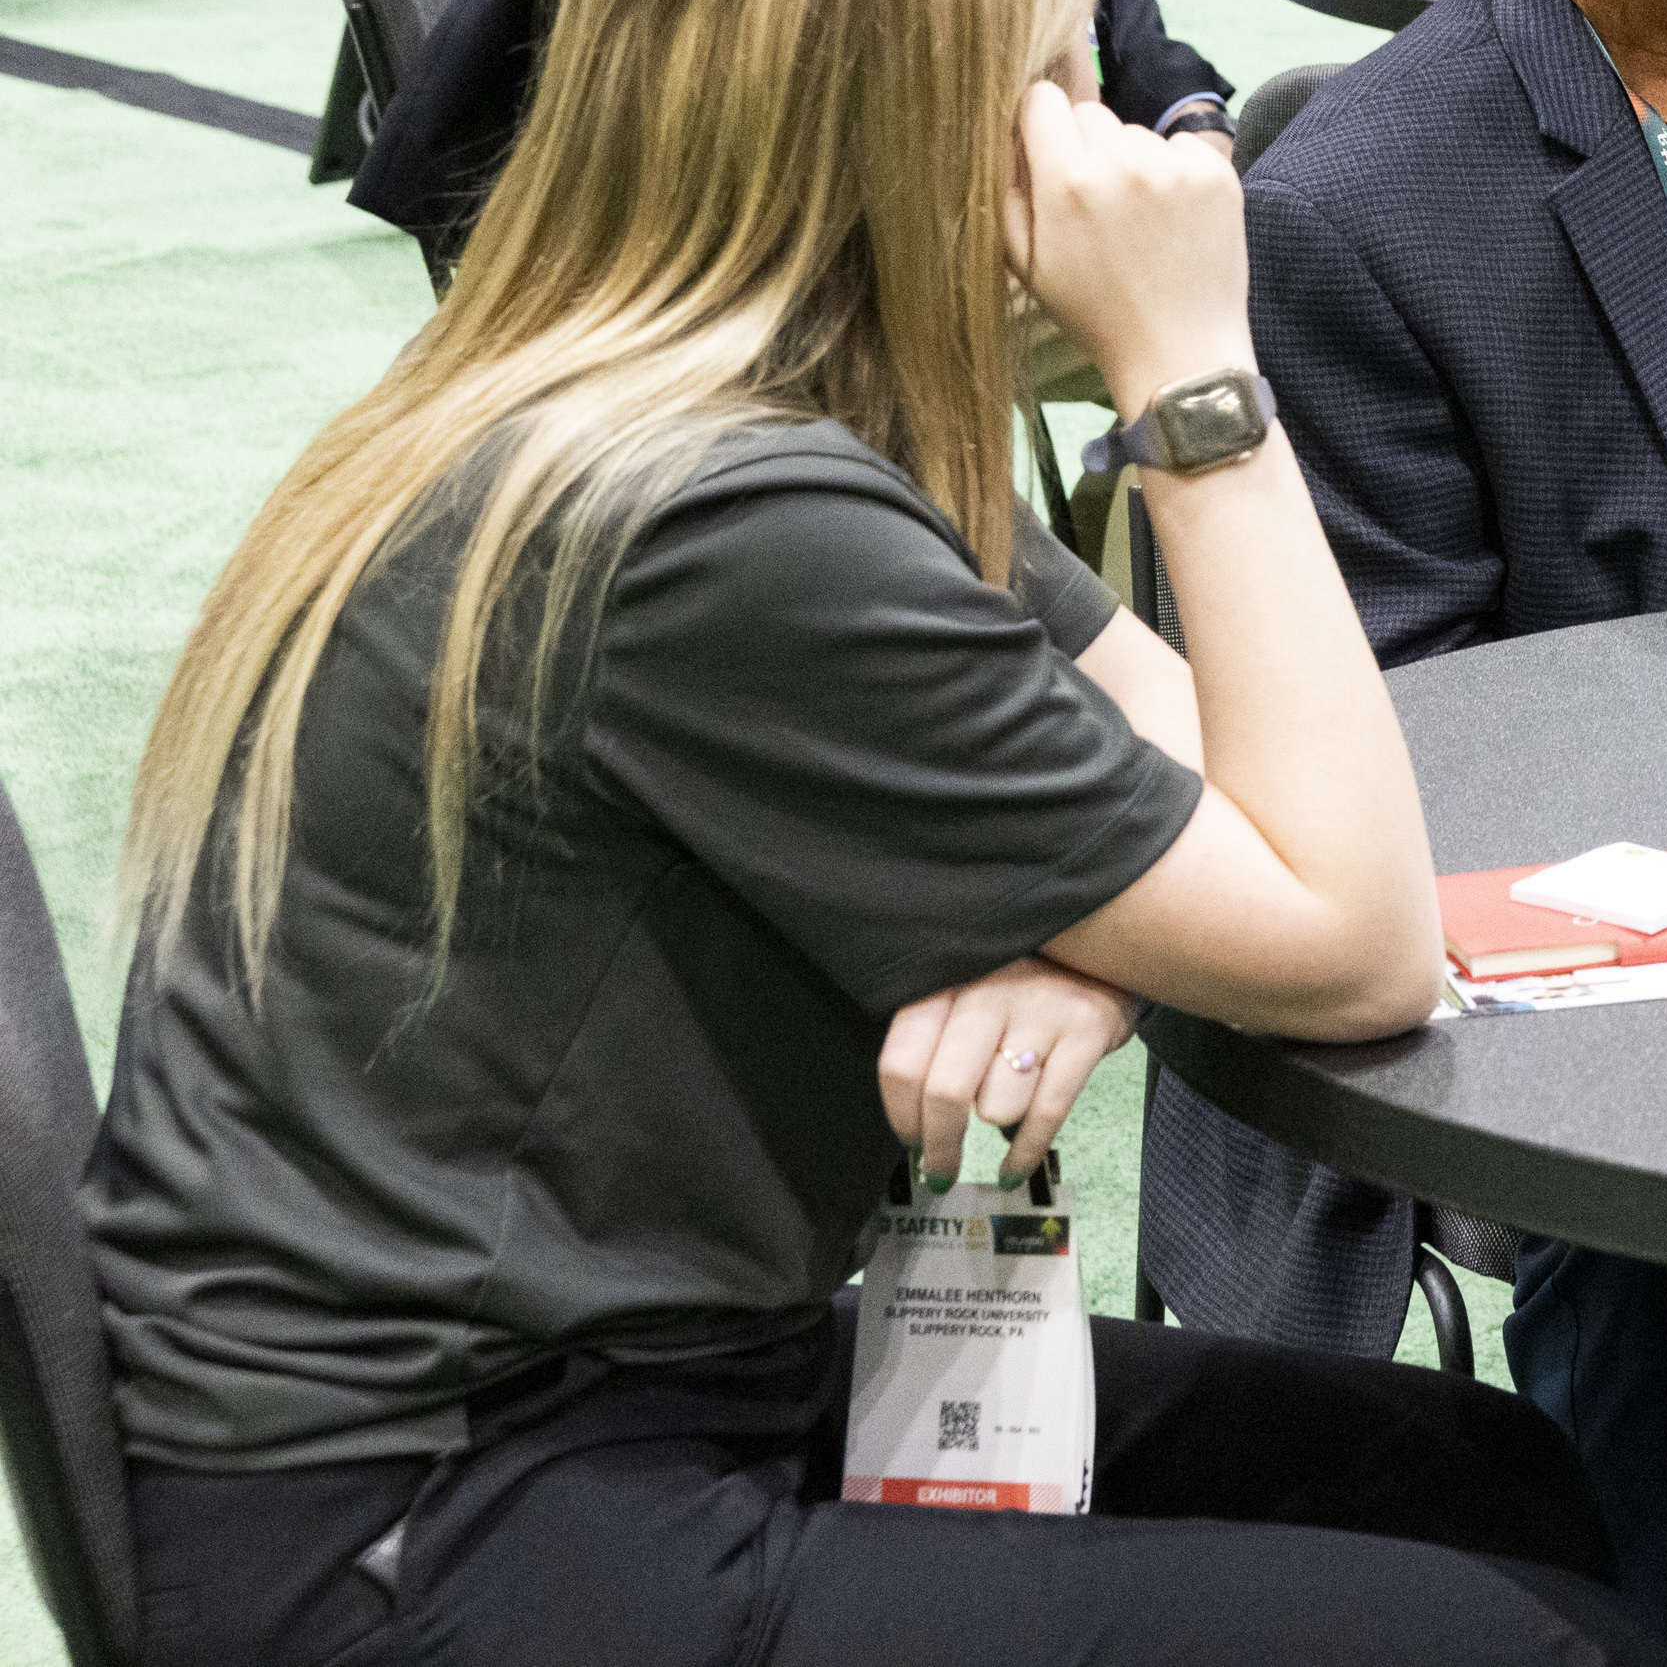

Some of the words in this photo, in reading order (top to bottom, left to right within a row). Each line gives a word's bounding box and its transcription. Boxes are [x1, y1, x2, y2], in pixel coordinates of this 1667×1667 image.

[896, 1215, 964, 1237] SAFETY
[896, 1287, 963, 1303] EMMALEE
[966, 1289, 1042, 1305] HENTHORN
[884, 1305, 942, 1320] SLIPPERY
[945, 1307, 978, 1320] ROCK
[981, 1310, 1051, 1322] UNIVERSITY
[909, 1323, 966, 1336] SLIPPERY
[1009, 1326, 1024, 1337] PA
[917, 1486, 997, 1505] EXHIBITOR
